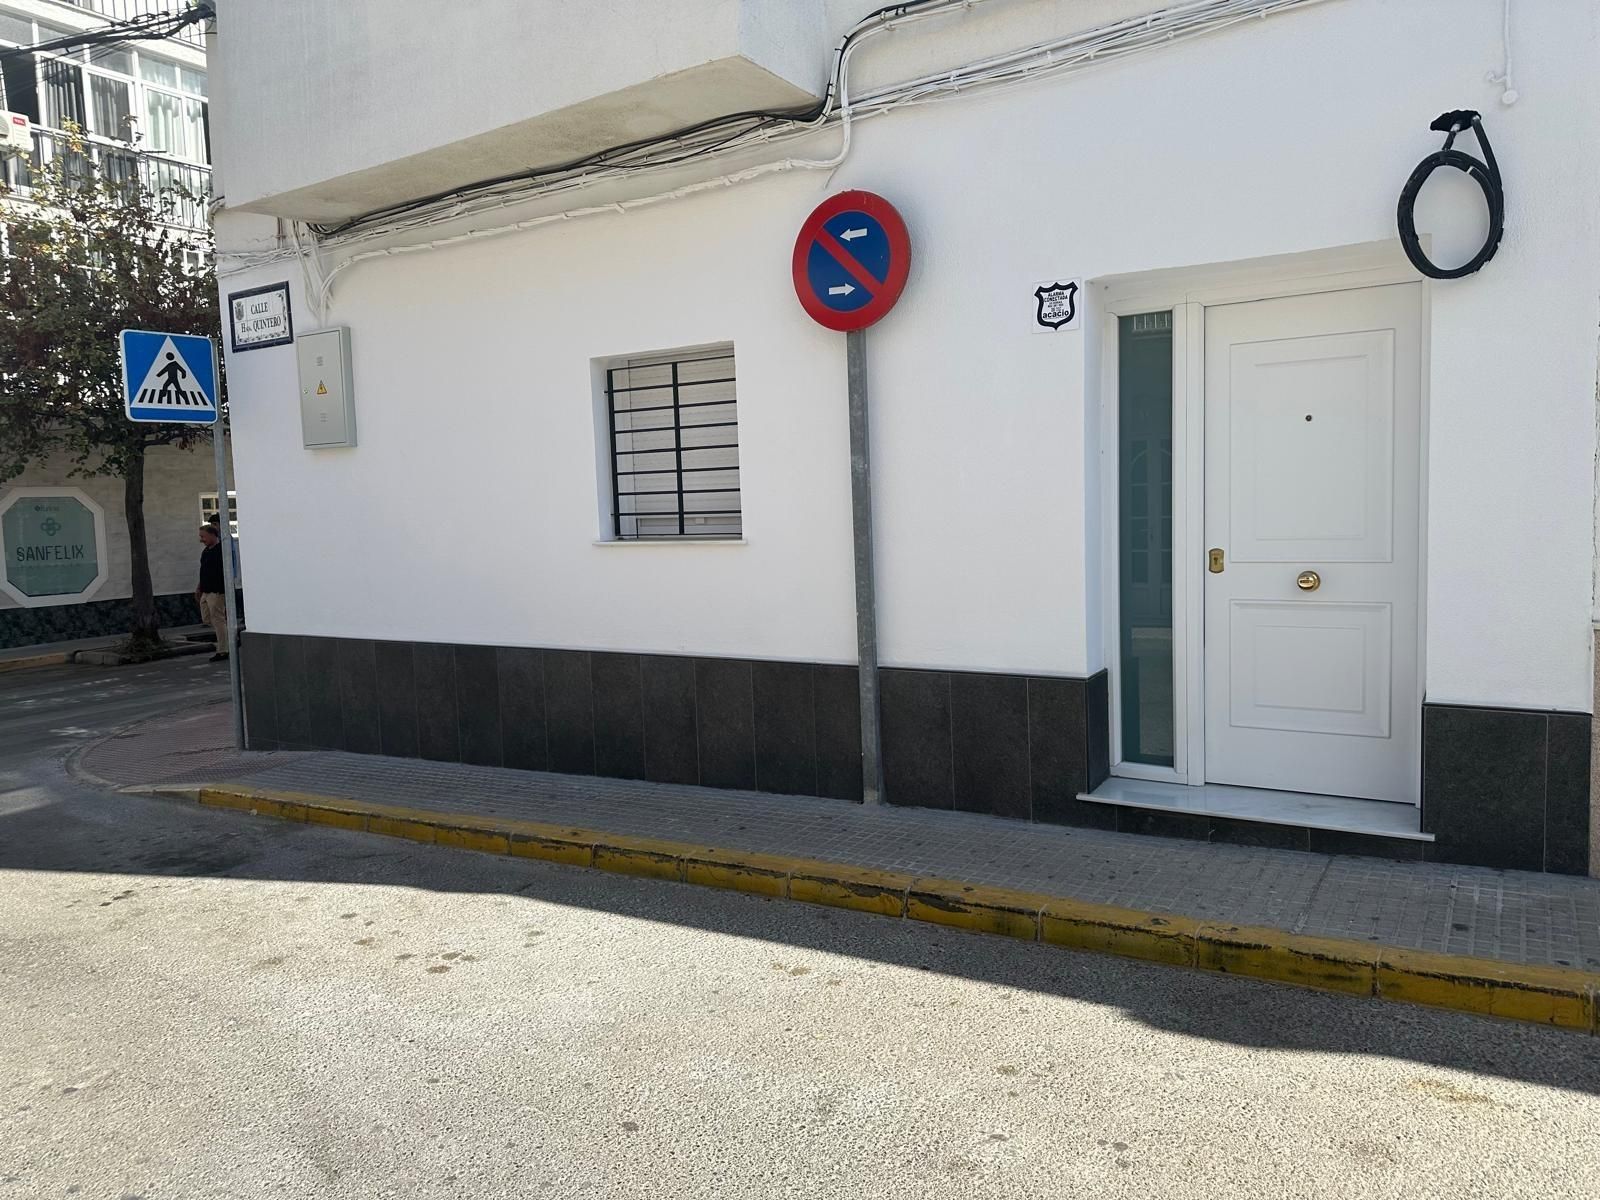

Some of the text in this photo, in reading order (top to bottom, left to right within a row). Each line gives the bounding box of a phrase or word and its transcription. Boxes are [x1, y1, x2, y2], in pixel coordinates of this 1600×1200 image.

[251, 302, 268, 314] CALLE
[1043, 309, 1069, 318] acacio
[253, 316, 281, 332] QUINTERO
[16, 545, 84, 561] SANFELIX
